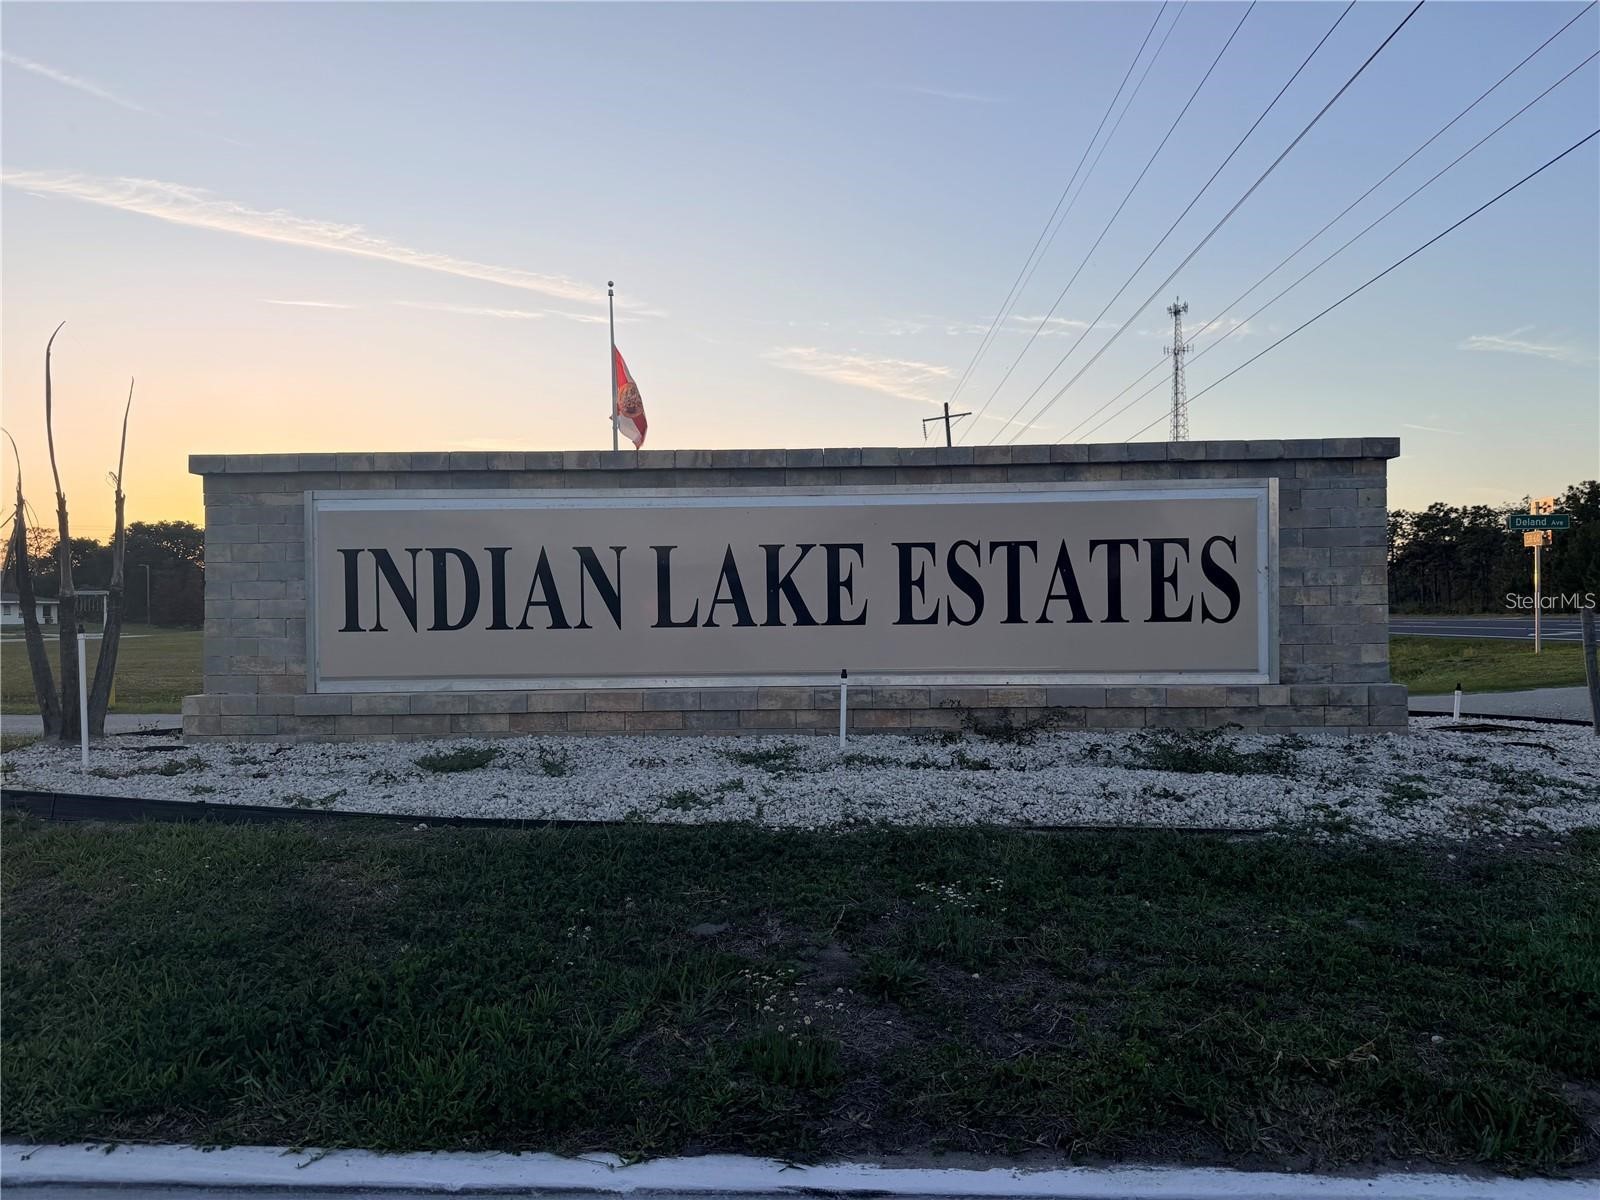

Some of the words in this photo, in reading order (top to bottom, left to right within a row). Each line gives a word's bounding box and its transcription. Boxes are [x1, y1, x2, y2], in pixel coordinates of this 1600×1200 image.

[1515, 517, 1547, 526] Deland
[336, 545, 628, 634] INDIAN
[649, 542, 868, 628] LAKE
[890, 535, 1241, 626] ESTATES
